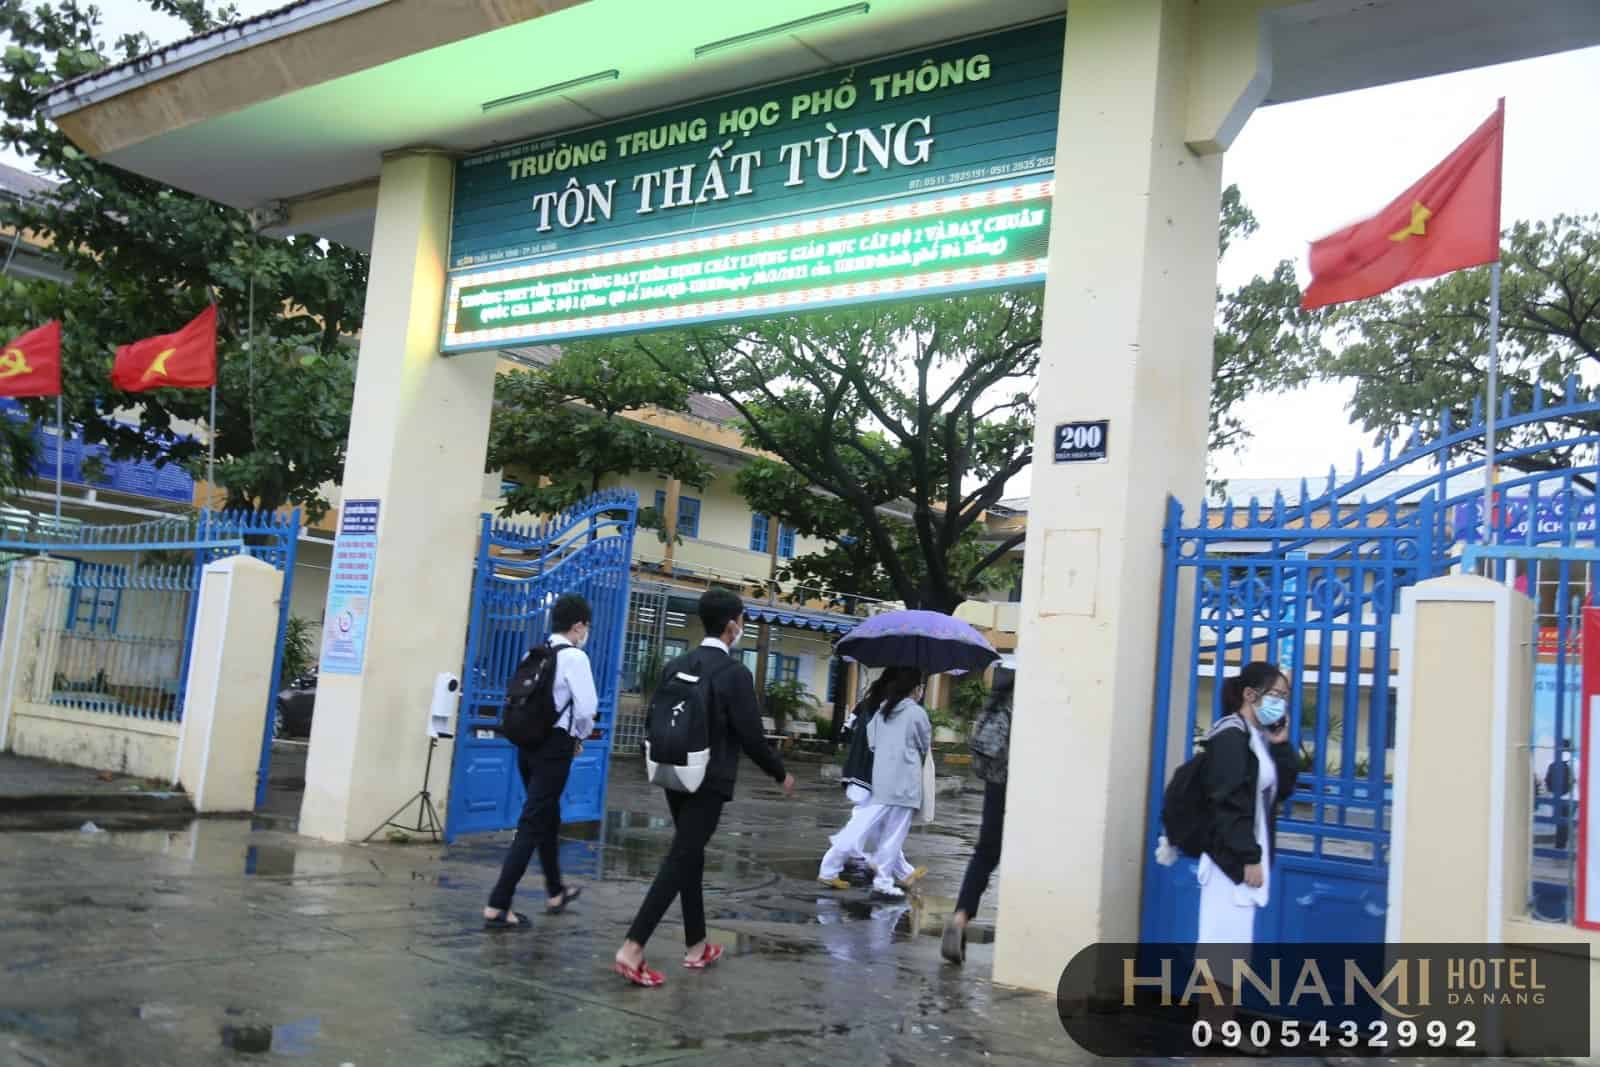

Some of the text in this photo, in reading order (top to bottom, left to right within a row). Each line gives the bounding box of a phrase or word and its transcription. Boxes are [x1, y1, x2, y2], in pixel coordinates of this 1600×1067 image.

[507, 140, 607, 180] TRƯỜNG
[616, 118, 707, 157] TRUNG
[719, 99, 780, 137] HỌC
[791, 68, 857, 120] PHỔ
[871, 53, 991, 101] THÔNG
[532, 115, 934, 231] TÔN THẤT TÙNG
[1060, 426, 1101, 449] 200
